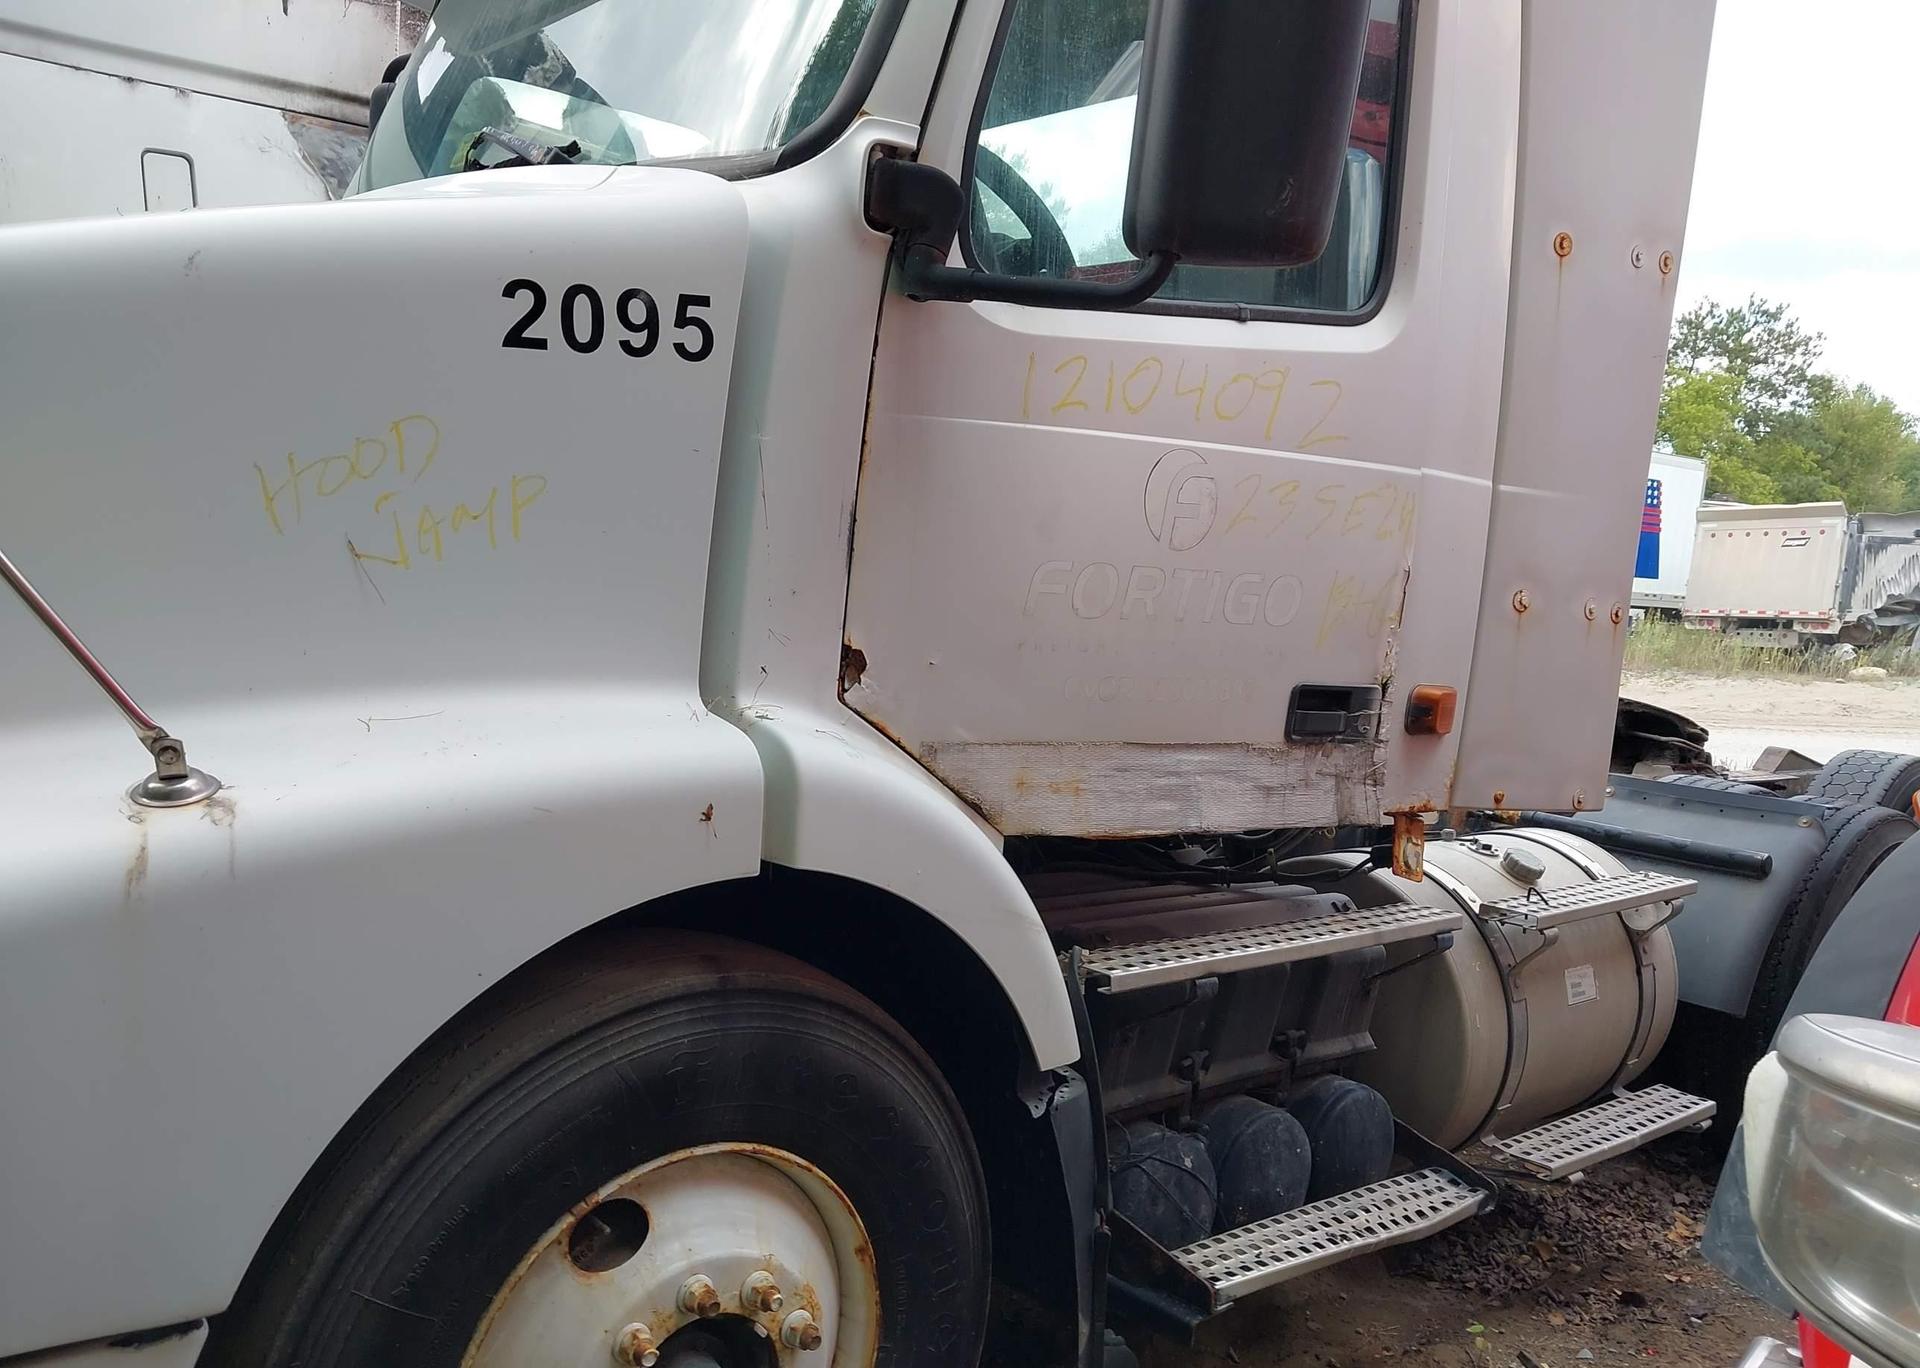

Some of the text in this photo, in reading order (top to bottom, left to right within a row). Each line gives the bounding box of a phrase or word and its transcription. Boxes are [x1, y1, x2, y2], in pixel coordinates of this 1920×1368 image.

[501, 278, 715, 362] 2095
[1022, 352, 1349, 449] 12104092
[253, 414, 441, 534] HOOD
[1023, 560, 1304, 627] FORTIGO
